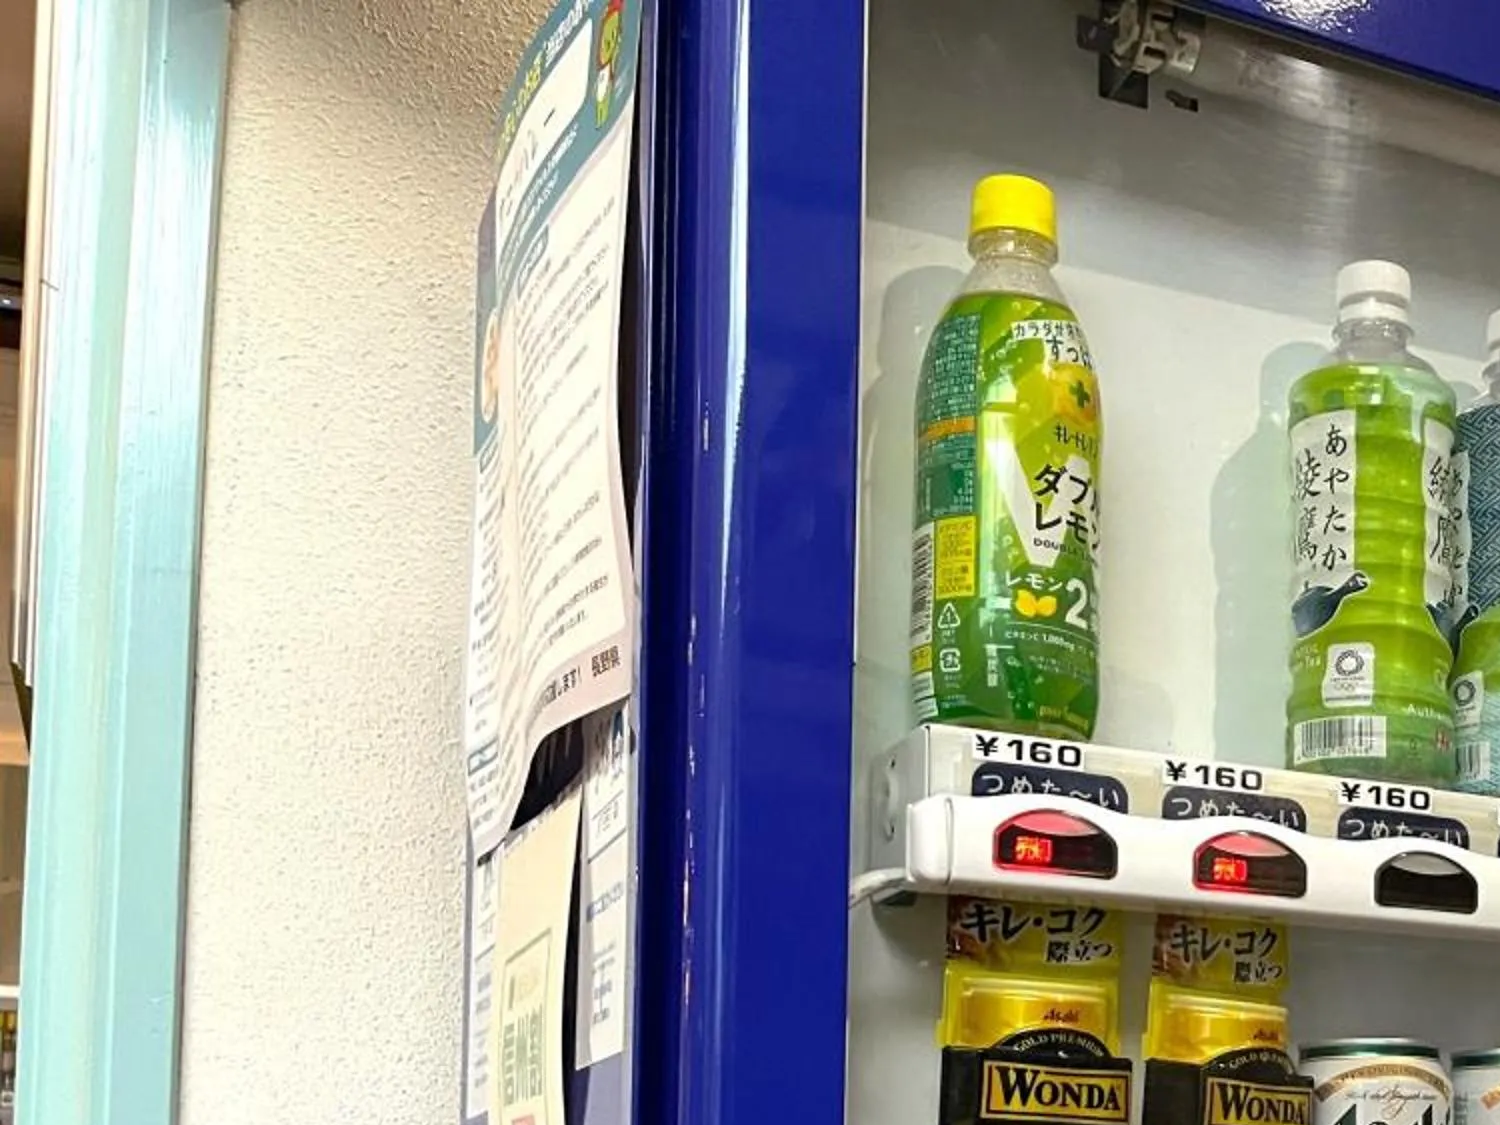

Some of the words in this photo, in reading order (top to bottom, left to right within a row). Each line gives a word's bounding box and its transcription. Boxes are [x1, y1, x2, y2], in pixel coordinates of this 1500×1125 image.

[1321, 424, 1349, 571] あやたか
[1006, 570, 1063, 592] レモン
[975, 734, 1082, 768] ¥160
[1166, 760, 1263, 791] ¥160
[1341, 782, 1430, 811] ¥160
[1045, 939, 1112, 964] 際立つ
[1234, 960, 1282, 984] 際立つ
[996, 1066, 1122, 1112] WONDA
